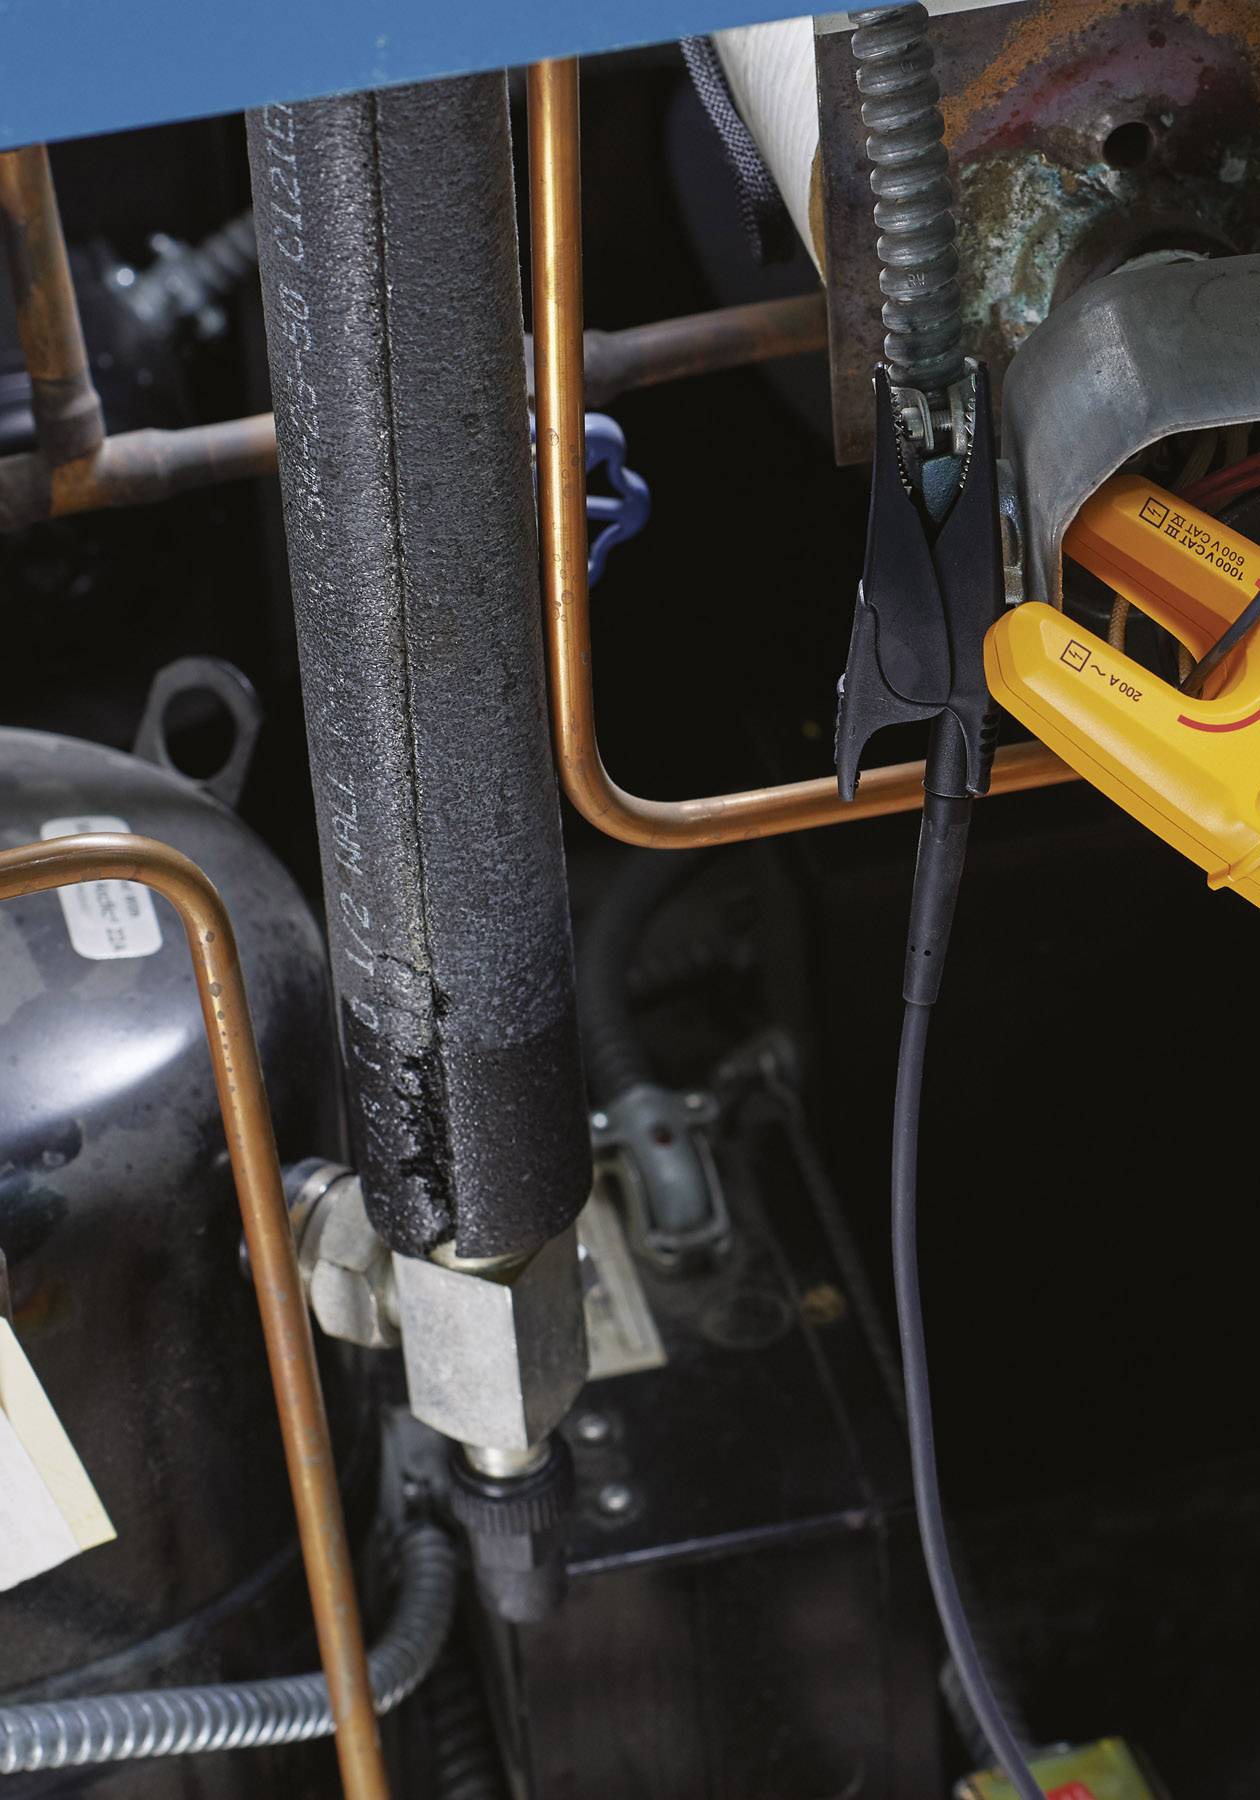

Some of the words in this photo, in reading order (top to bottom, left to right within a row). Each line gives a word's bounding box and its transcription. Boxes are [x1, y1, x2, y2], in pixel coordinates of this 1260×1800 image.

[1170, 513, 1187, 528] IV
[1164, 524, 1181, 539] III
[1185, 523, 1211, 546] CAT
[1223, 546, 1245, 565] 600
[1215, 556, 1243, 582] 1000
[1108, 674, 1121, 686] A
[1118, 678, 1142, 702] 200
[326, 769, 364, 876] WALL
